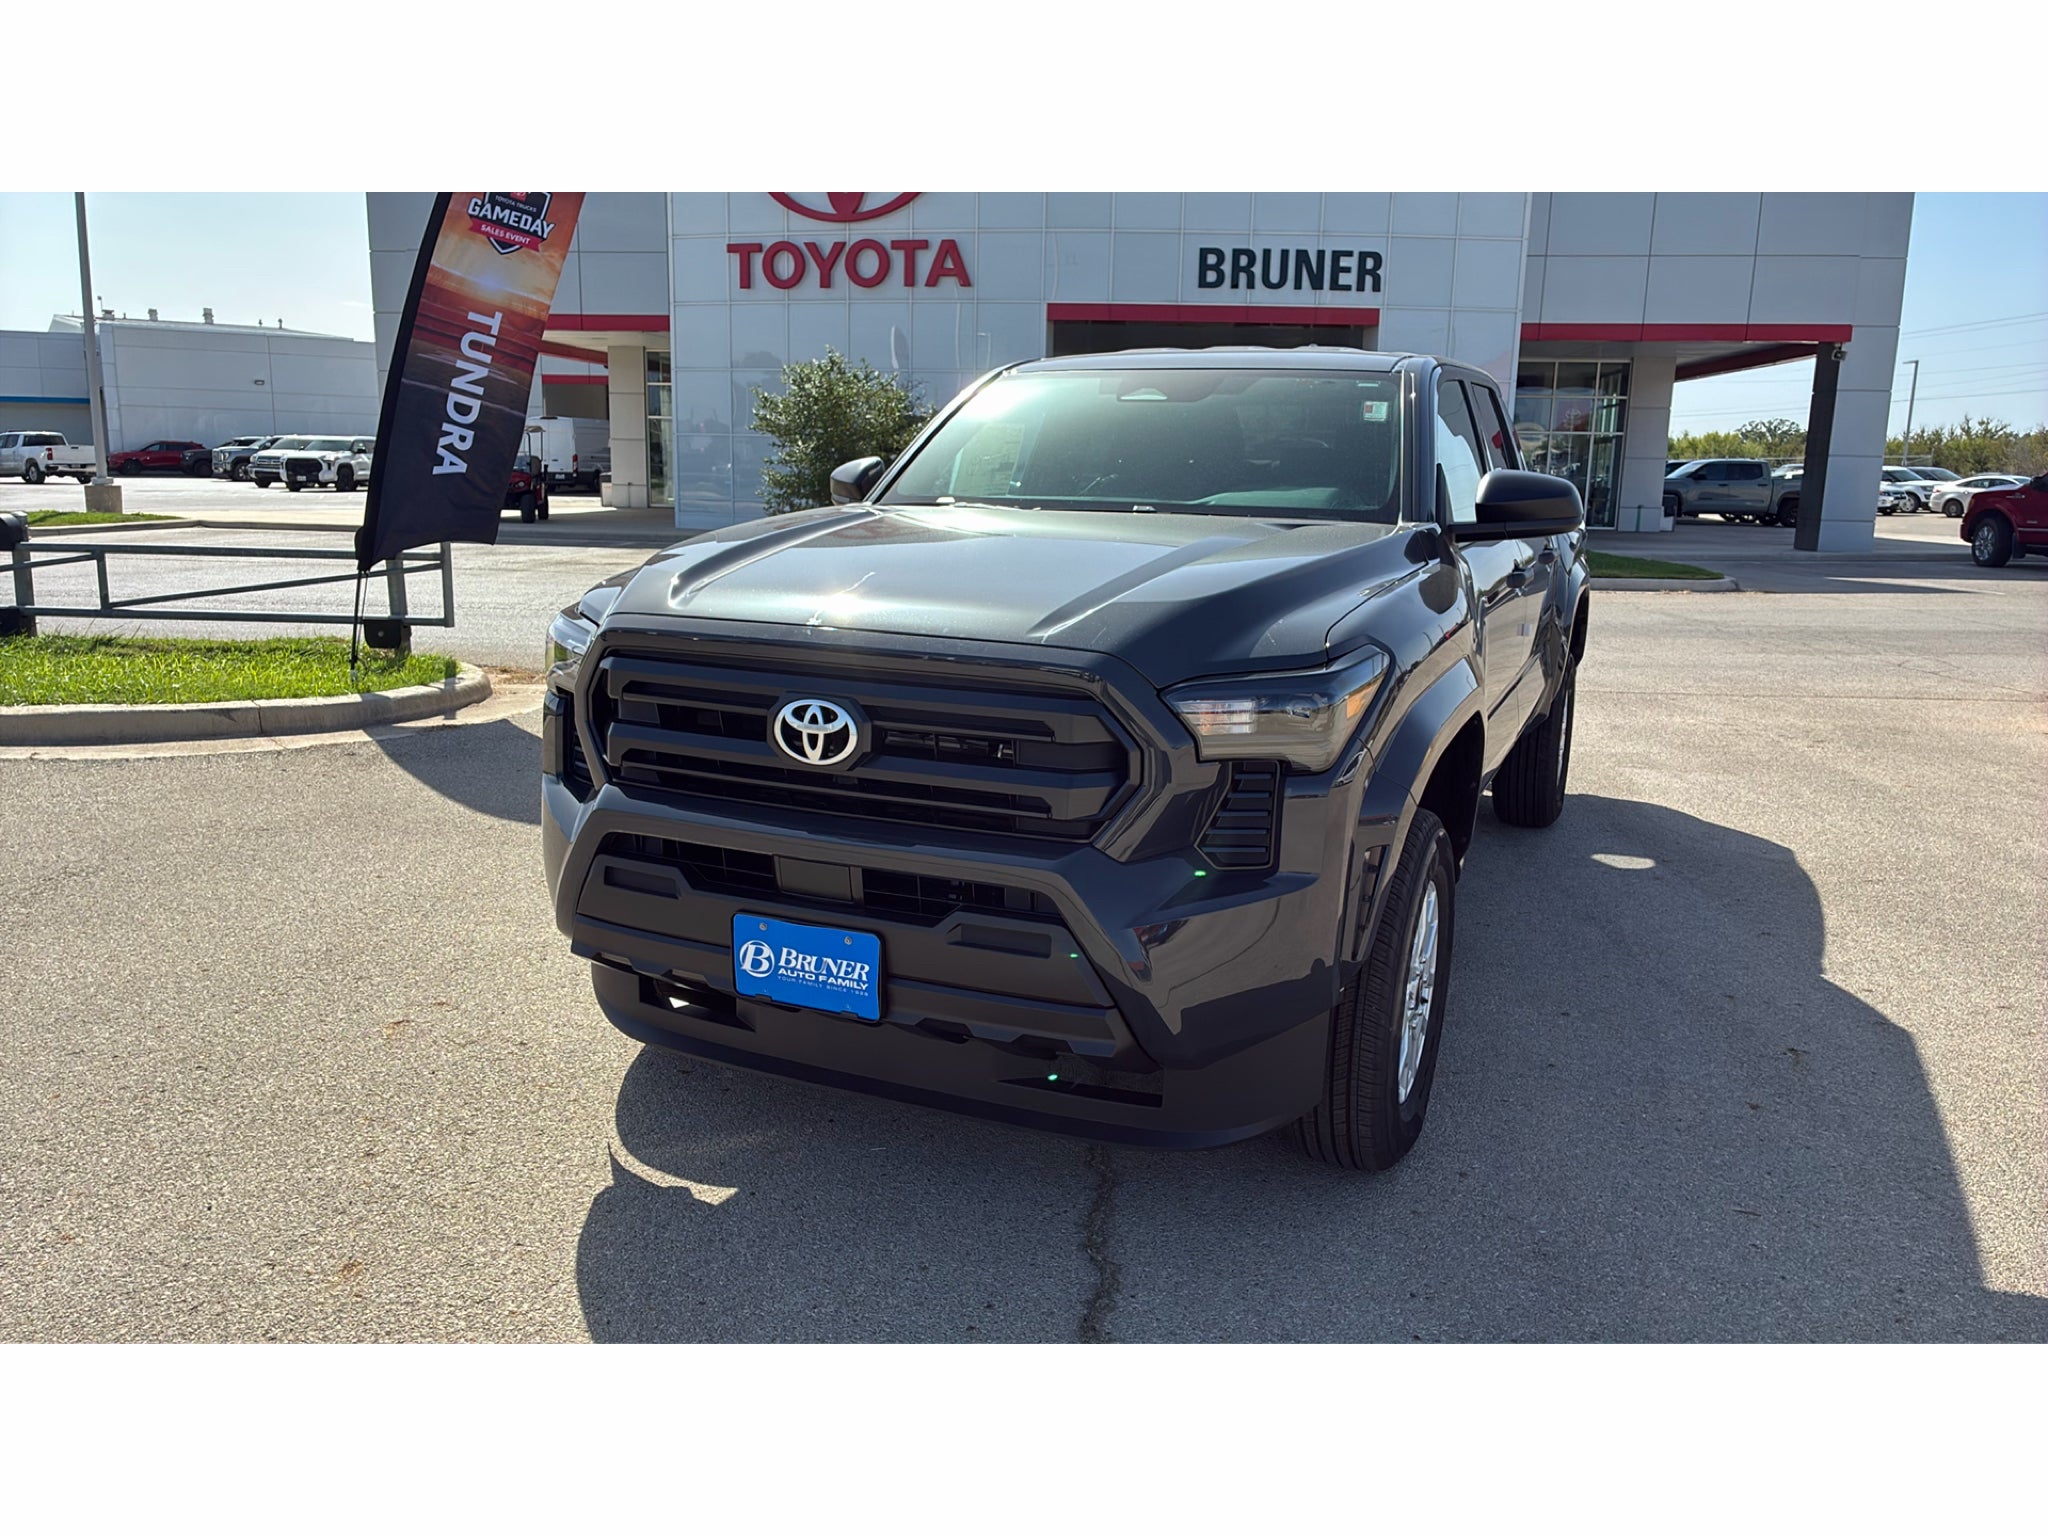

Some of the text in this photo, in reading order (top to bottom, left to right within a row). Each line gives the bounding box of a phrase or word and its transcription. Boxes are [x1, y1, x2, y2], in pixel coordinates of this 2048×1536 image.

[468, 197, 555, 239] GAMEDAY
[480, 224, 531, 245] SALES EVENT
[726, 238, 972, 290] TOYOTA
[1198, 247, 1383, 292] BRUNER
[432, 311, 503, 476] TUNDRA
[778, 947, 870, 982] BRUNER
[778, 968, 869, 991] AUTO FAMILY
